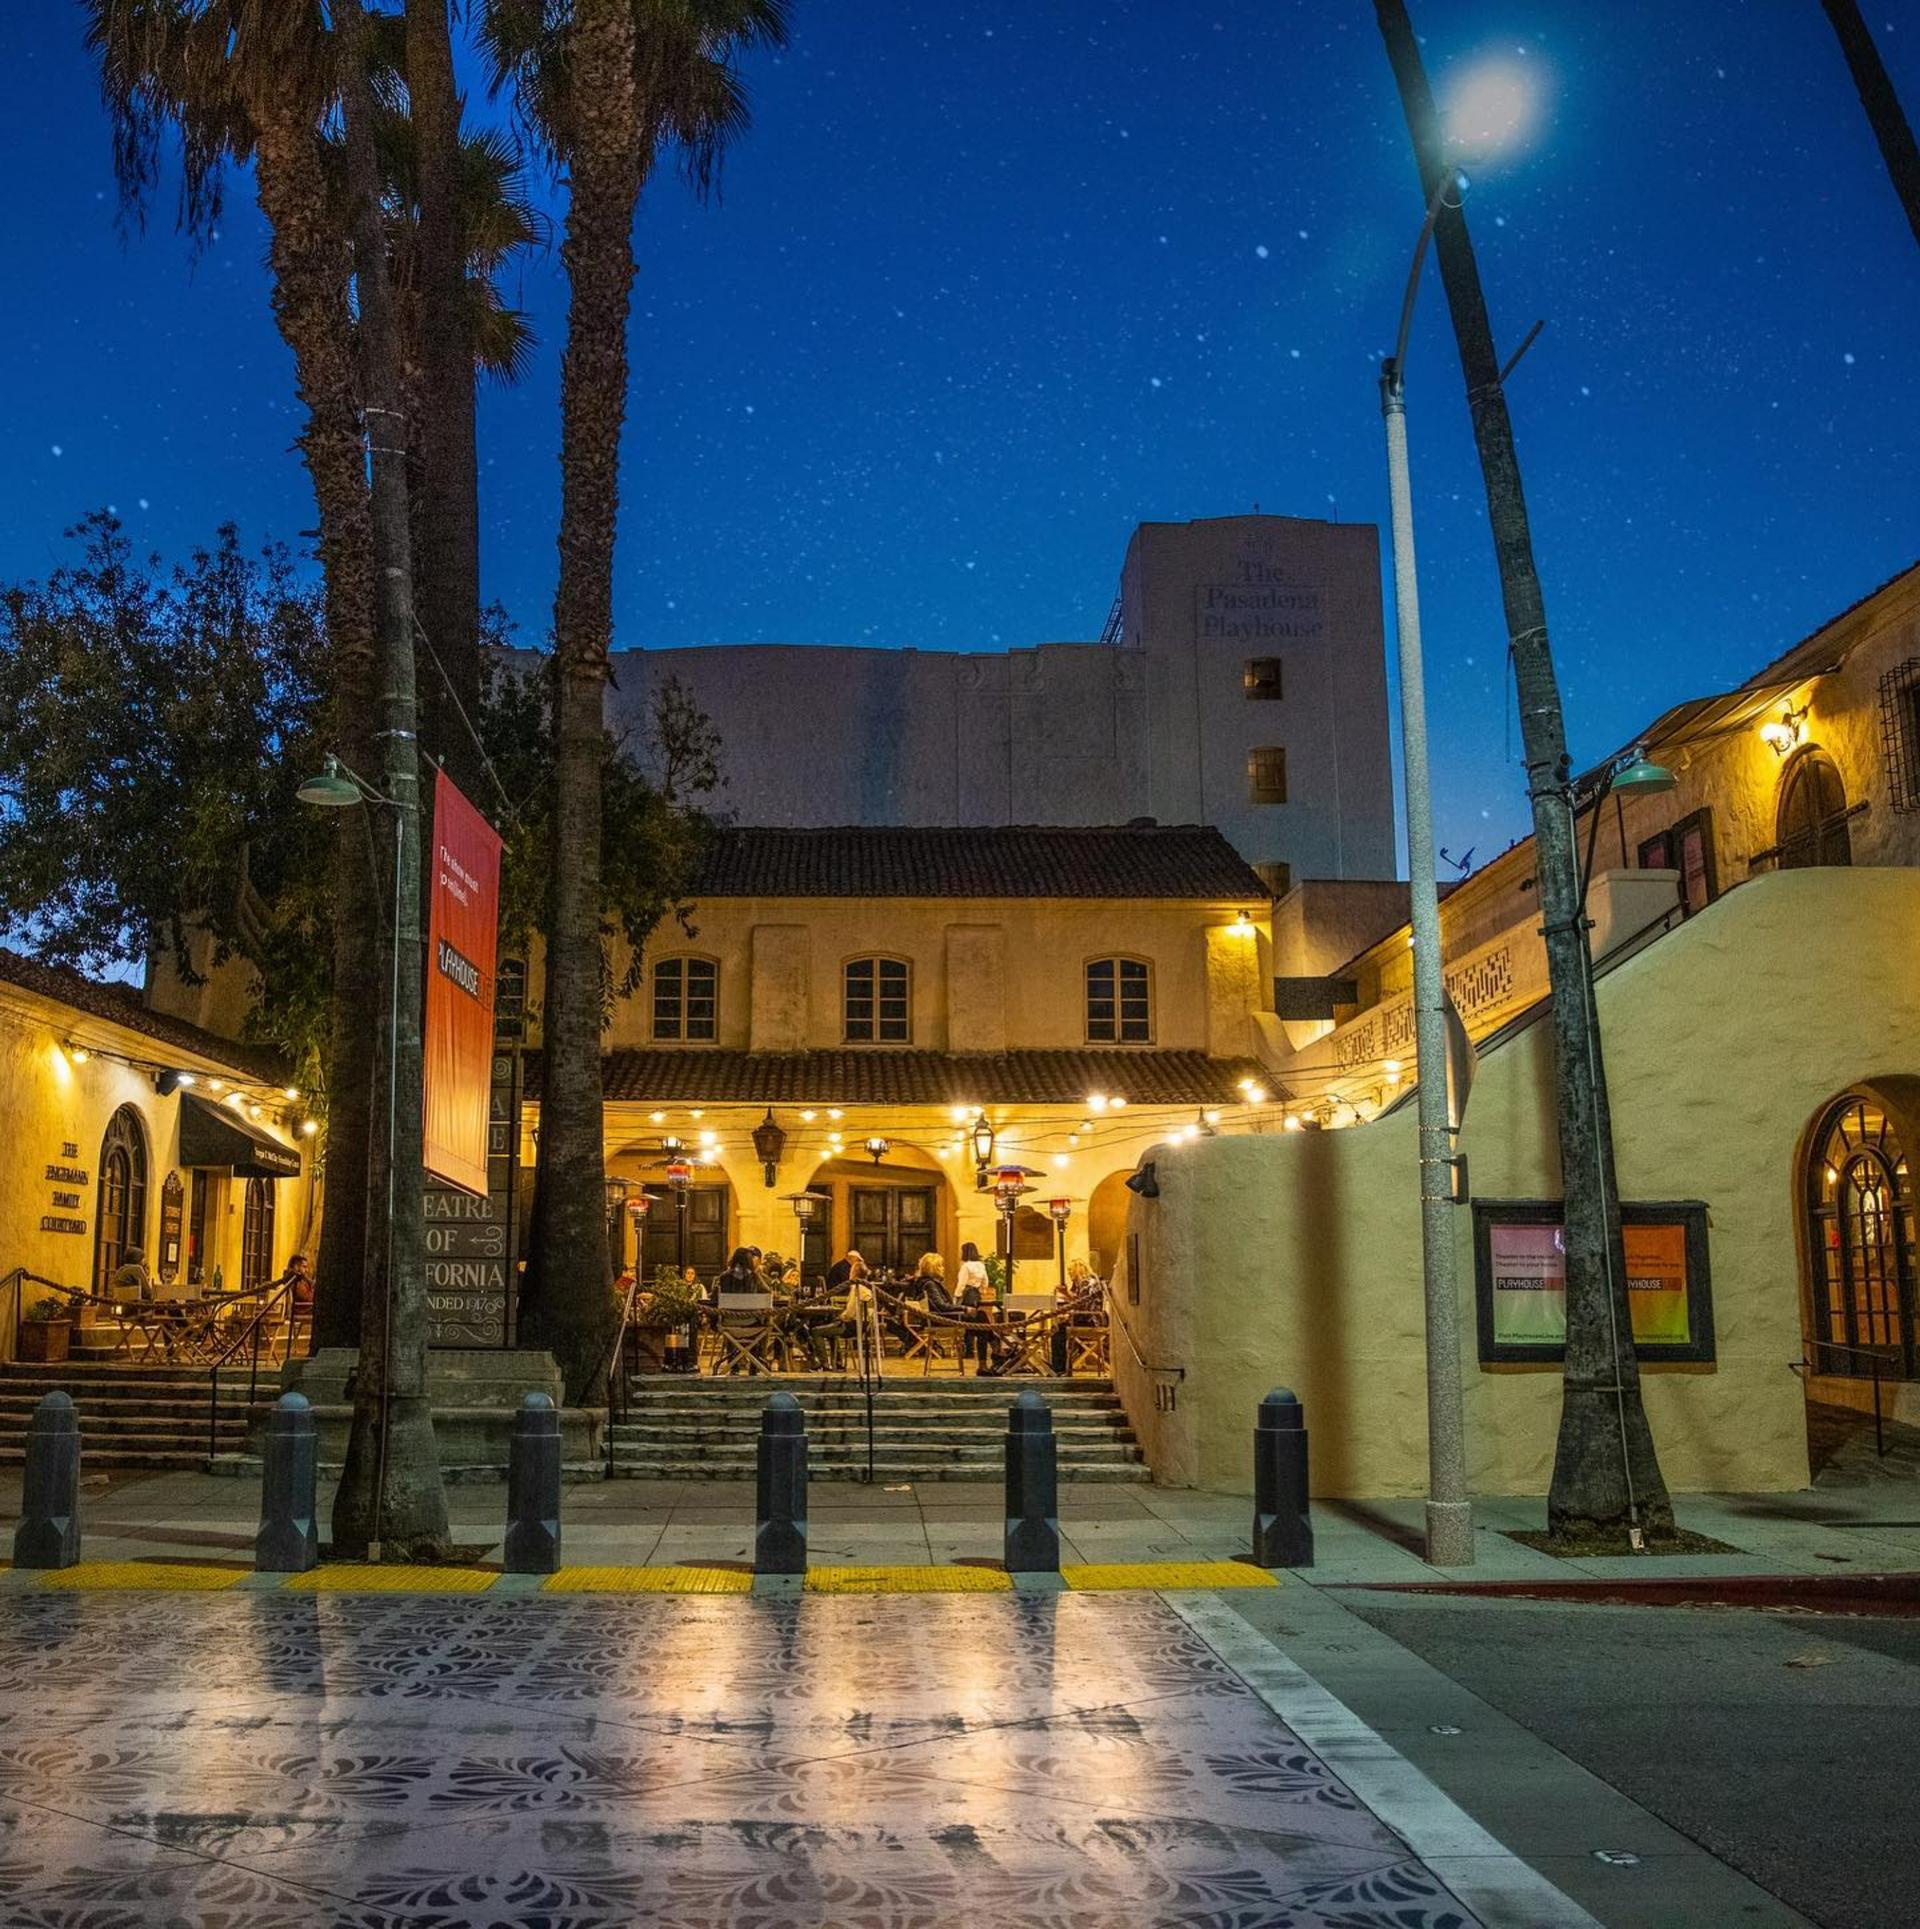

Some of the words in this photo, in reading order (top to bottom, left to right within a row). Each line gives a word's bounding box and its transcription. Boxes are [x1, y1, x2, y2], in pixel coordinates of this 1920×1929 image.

[1239, 560, 1284, 583] The
[1206, 587, 1319, 609] Pasadena
[1204, 614, 1322, 641] Playhouse
[61, 1142, 79, 1159] THE
[423, 1194, 494, 1220] EATRE
[40, 1216, 87, 1235] COURTYARD
[426, 1229, 458, 1252] OF
[426, 1263, 504, 1288] FORNIA
[1498, 1279, 1545, 1289] PLAYHOUSE
[1627, 1279, 1662, 1289] YHOUSE
[427, 1296, 464, 1311] NDED
